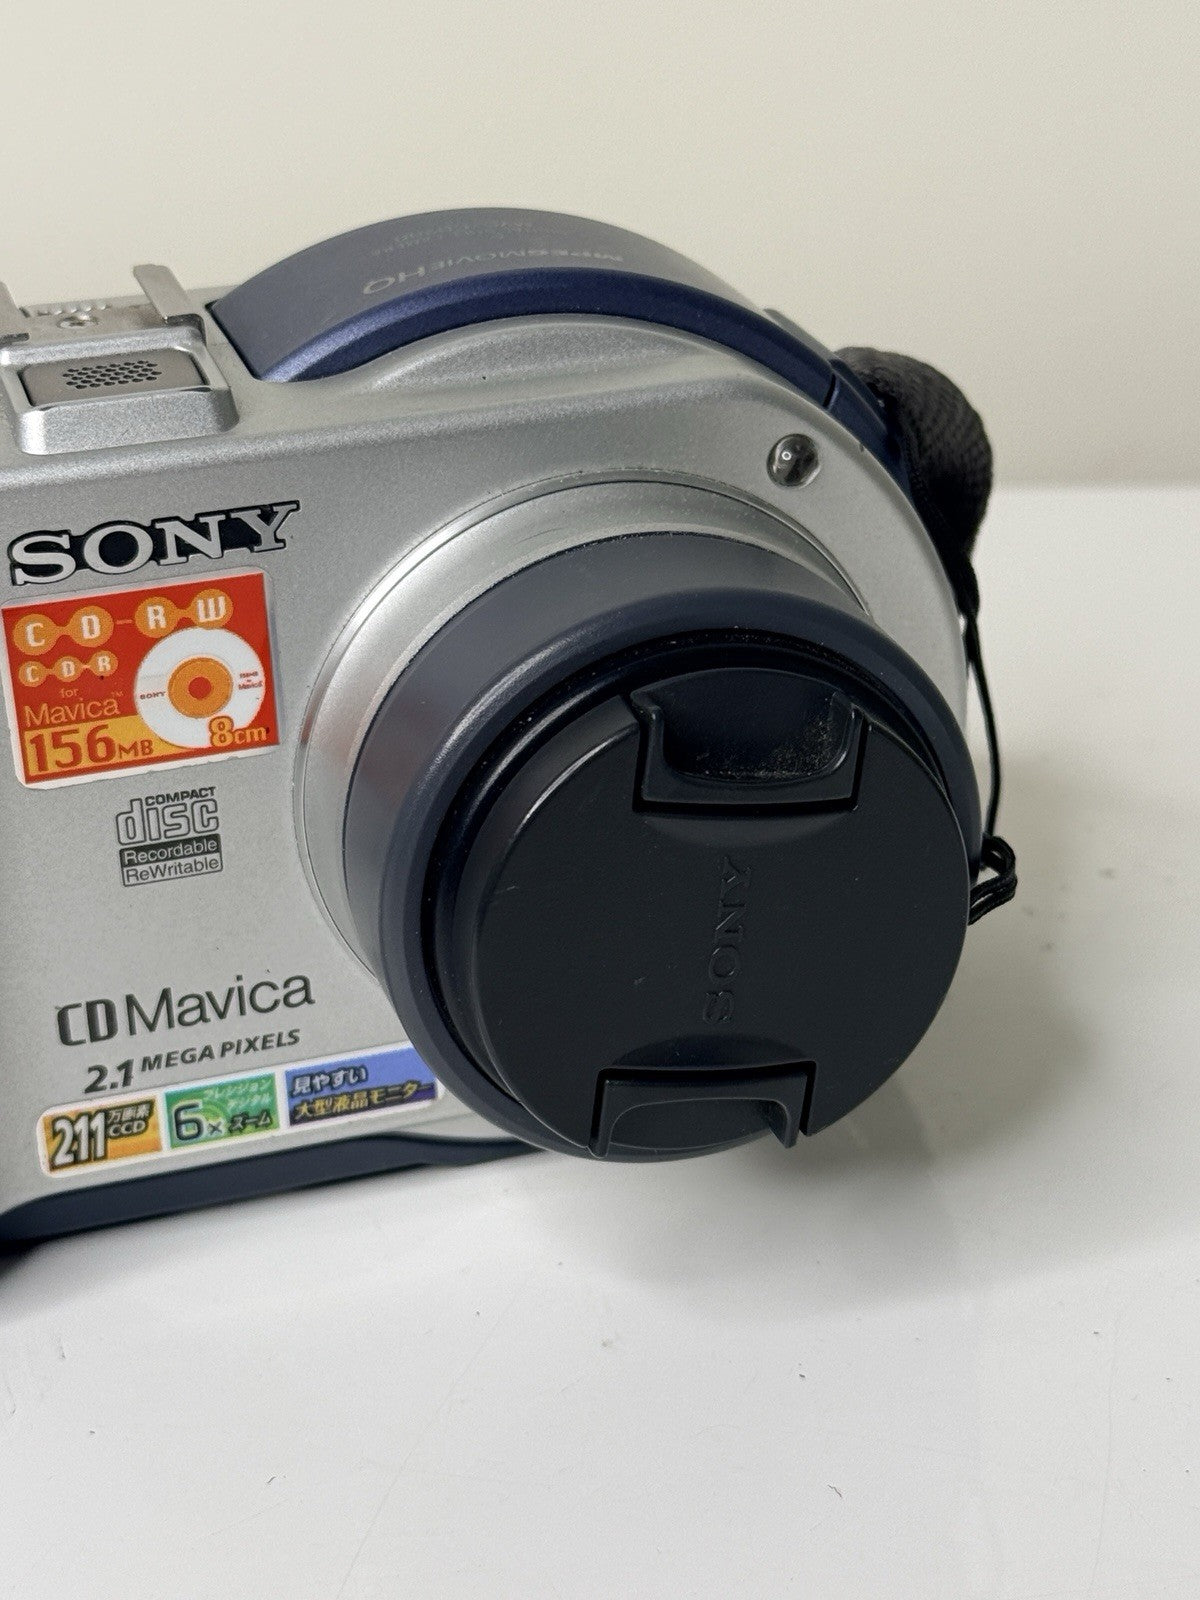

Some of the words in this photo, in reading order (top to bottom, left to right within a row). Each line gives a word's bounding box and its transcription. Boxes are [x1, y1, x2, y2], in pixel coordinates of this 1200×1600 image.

[8, 500, 300, 586] SONY
[60, 688, 79, 698] for
[24, 698, 121, 728] Mavica
[209, 715, 268, 748] 8cm
[144, 786, 216, 807] COMPACT
[115, 798, 219, 846] disc
[124, 838, 218, 866] Recordable
[126, 857, 220, 883] ReWritable
[702, 855, 751, 1024] SONY
[125, 974, 316, 1036] Mavica
[84, 1058, 135, 1094] 2.1
[140, 1044, 216, 1073] MEGA
[220, 1029, 301, 1058] PIXELS
[293, 1066, 368, 1097] 見やすい
[53, 1111, 105, 1167] 211
[107, 1119, 147, 1138] CCD
